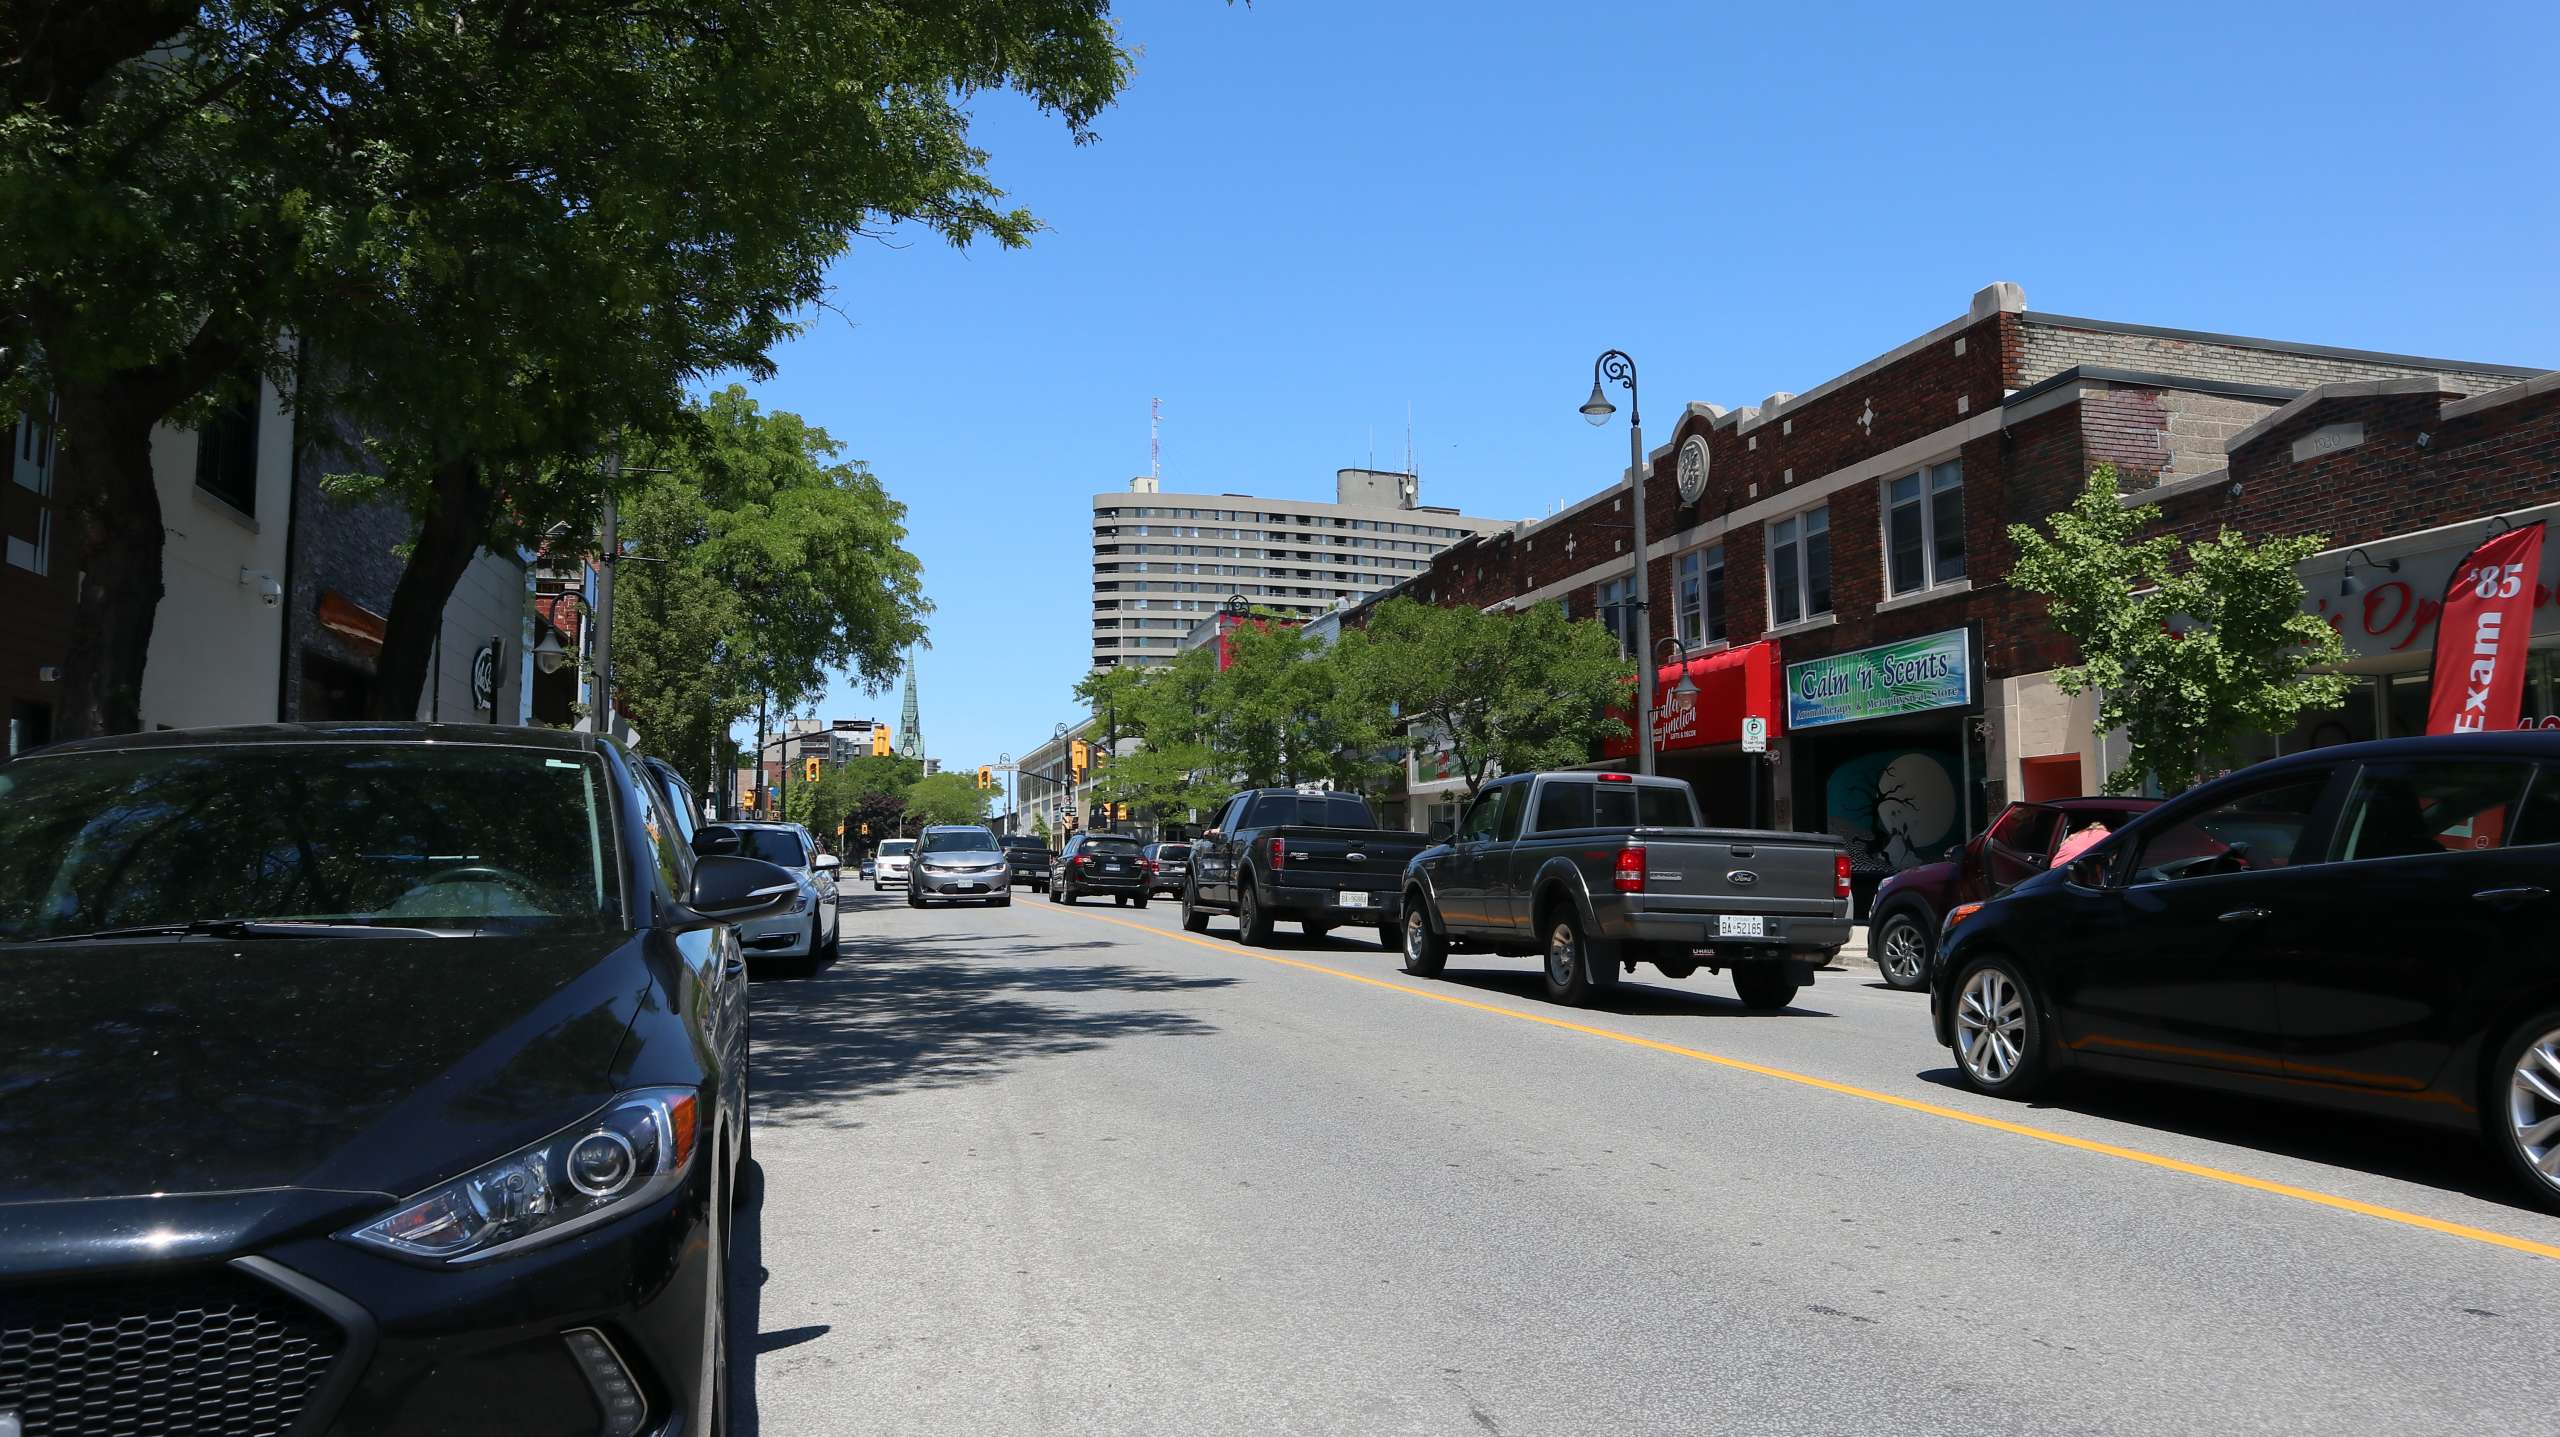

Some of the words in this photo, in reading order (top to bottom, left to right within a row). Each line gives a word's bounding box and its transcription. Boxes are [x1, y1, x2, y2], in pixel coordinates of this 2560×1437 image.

[1802, 667, 1849, 700] Calm
[1884, 654, 1948, 687] Scents
[2453, 612, 2503, 735] Exam
[1867, 692, 1928, 709] Metaphysical
[1931, 687, 1959, 698] Store
[1734, 872, 1753, 882] Ford
